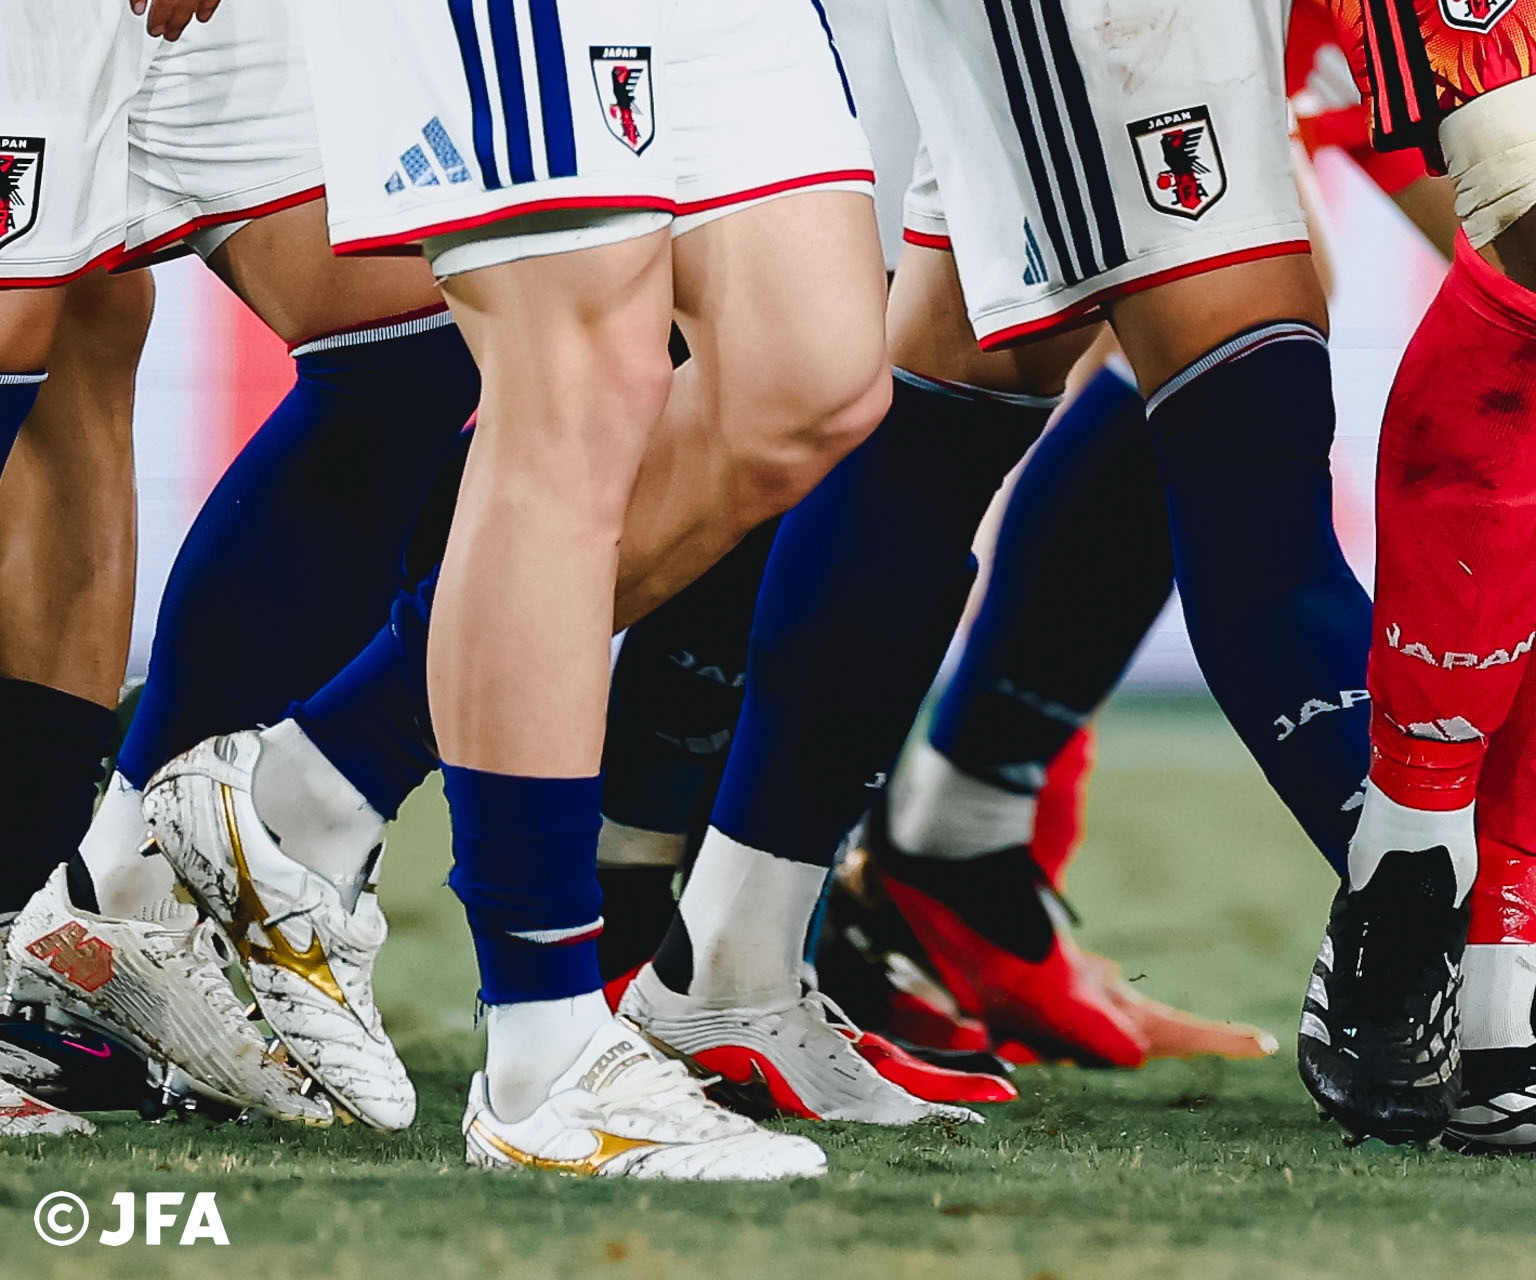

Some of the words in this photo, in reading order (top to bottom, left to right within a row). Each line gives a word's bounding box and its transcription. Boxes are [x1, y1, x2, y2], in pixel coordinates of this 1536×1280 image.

[603, 47, 637, 58] JAPAN
[1148, 111, 1191, 130] JAPAN
[0, 138, 27, 149] PAN
[1386, 623, 1536, 670] JAPAN
[1273, 689, 1371, 741] JAP
